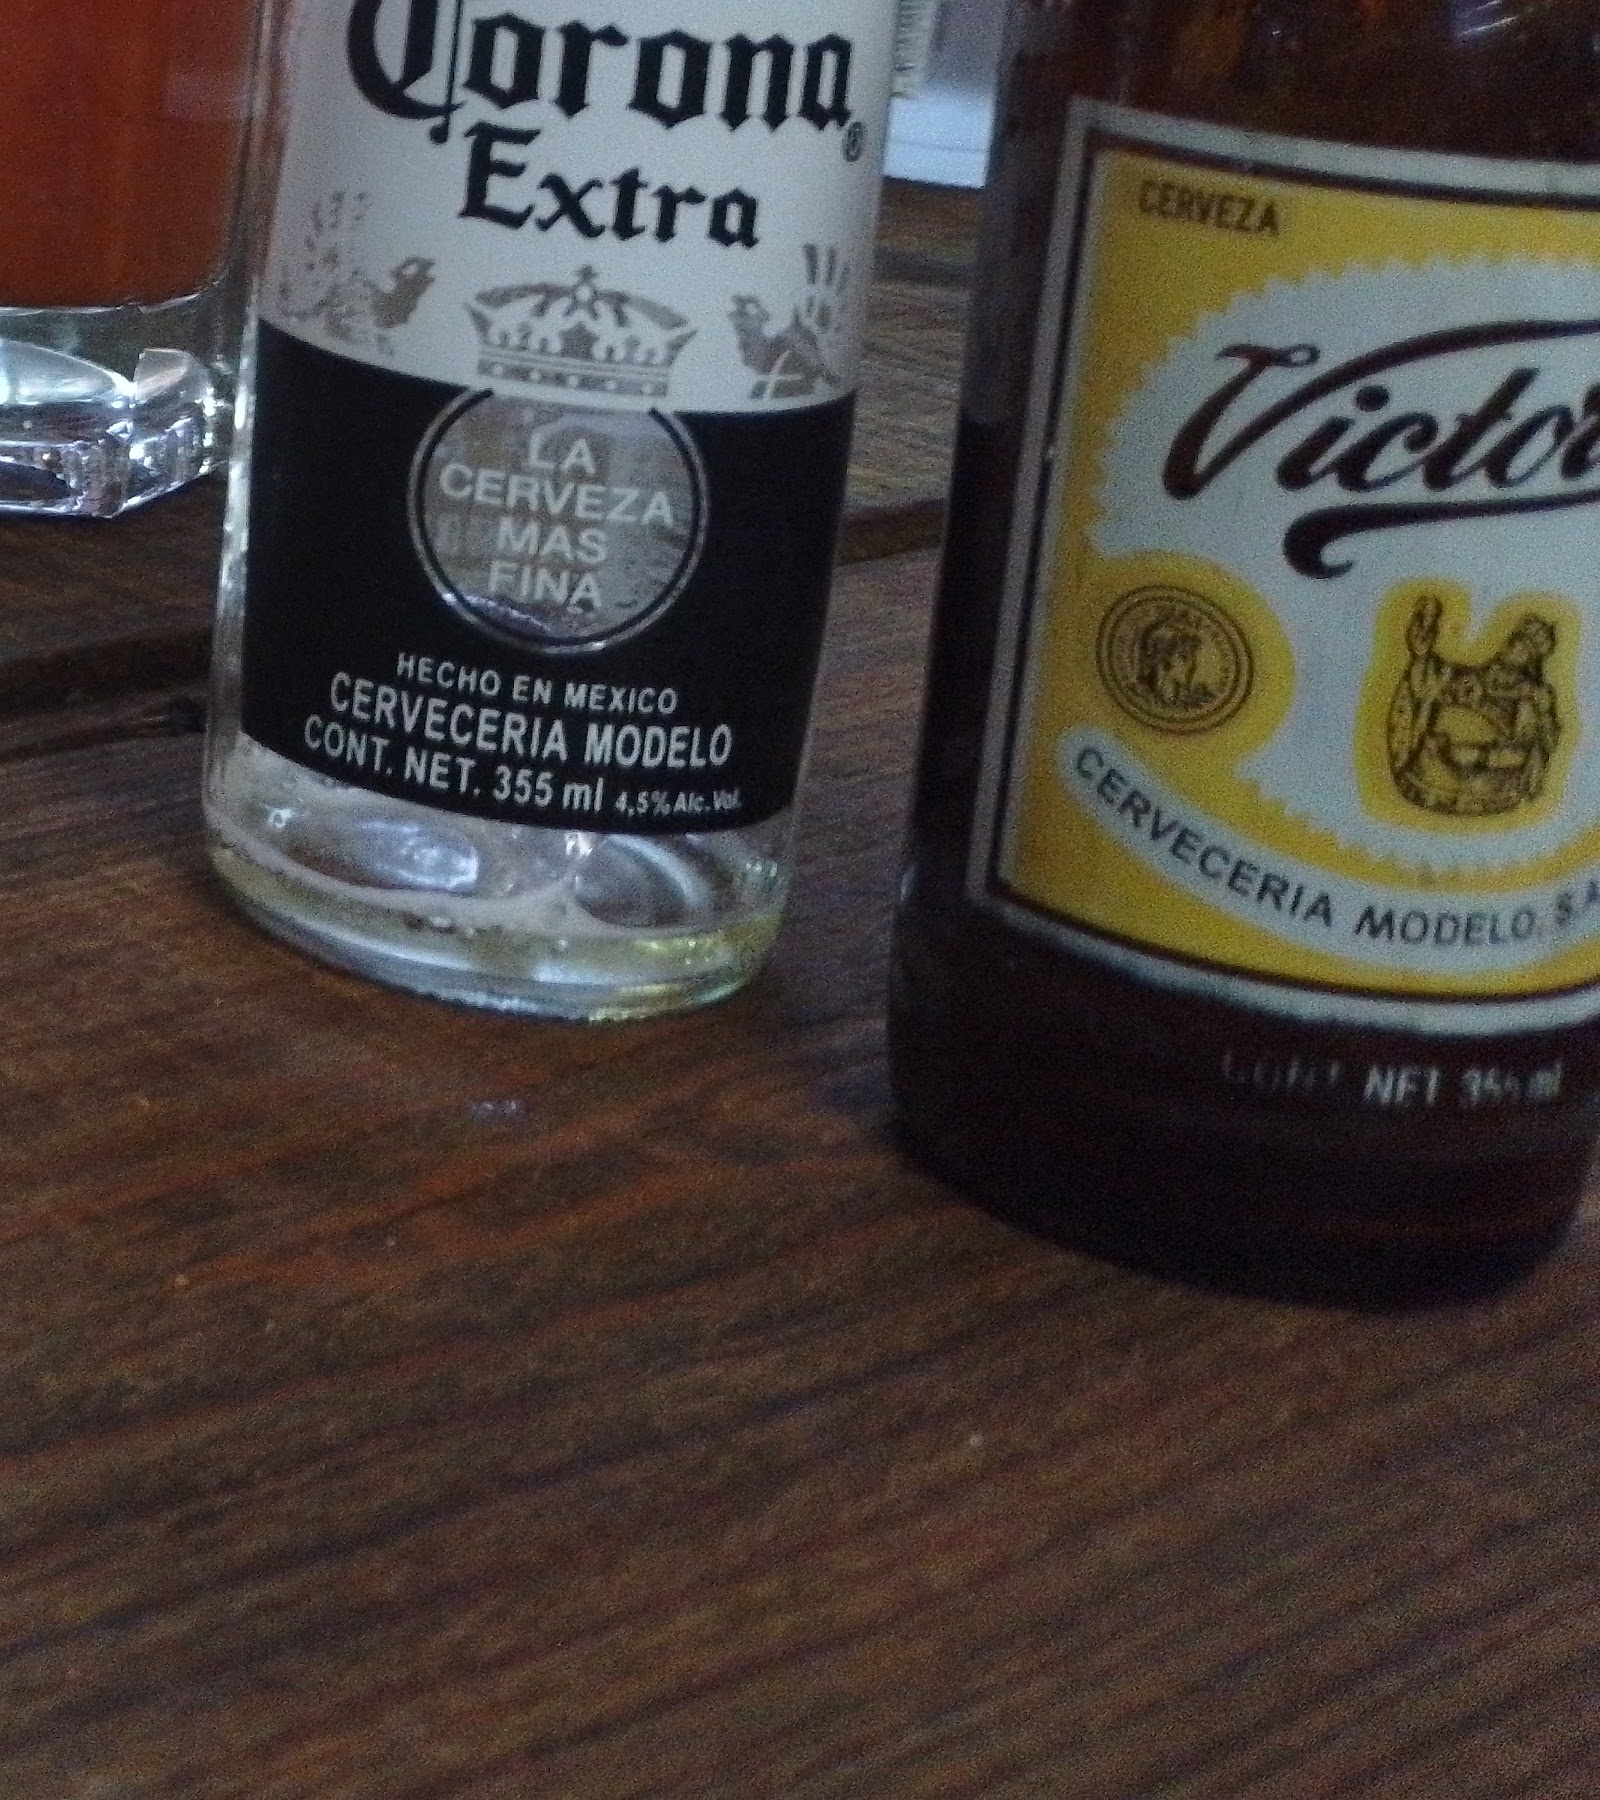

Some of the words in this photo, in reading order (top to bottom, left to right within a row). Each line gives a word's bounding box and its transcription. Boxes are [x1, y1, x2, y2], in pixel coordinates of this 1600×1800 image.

[458, 121, 759, 249] Extra
[1139, 179, 1280, 236] CERVEZA
[528, 430, 596, 474] LA
[439, 462, 674, 528] CERVEZA
[497, 516, 607, 563] MAS
[488, 560, 602, 606] FINA
[396, 652, 500, 697] HECHO
[511, 675, 553, 706] EN
[564, 681, 679, 716] MEXICO
[329, 671, 568, 762] CERVECERIA
[584, 722, 733, 768] MODELO
[303, 713, 393, 776] CONT.
[403, 745, 481, 797] NET.
[493, 764, 554, 808] 355
[562, 776, 605, 814] ml
[1074, 746, 1334, 928] CERVECERIA
[1354, 904, 1535, 947] MODELO
